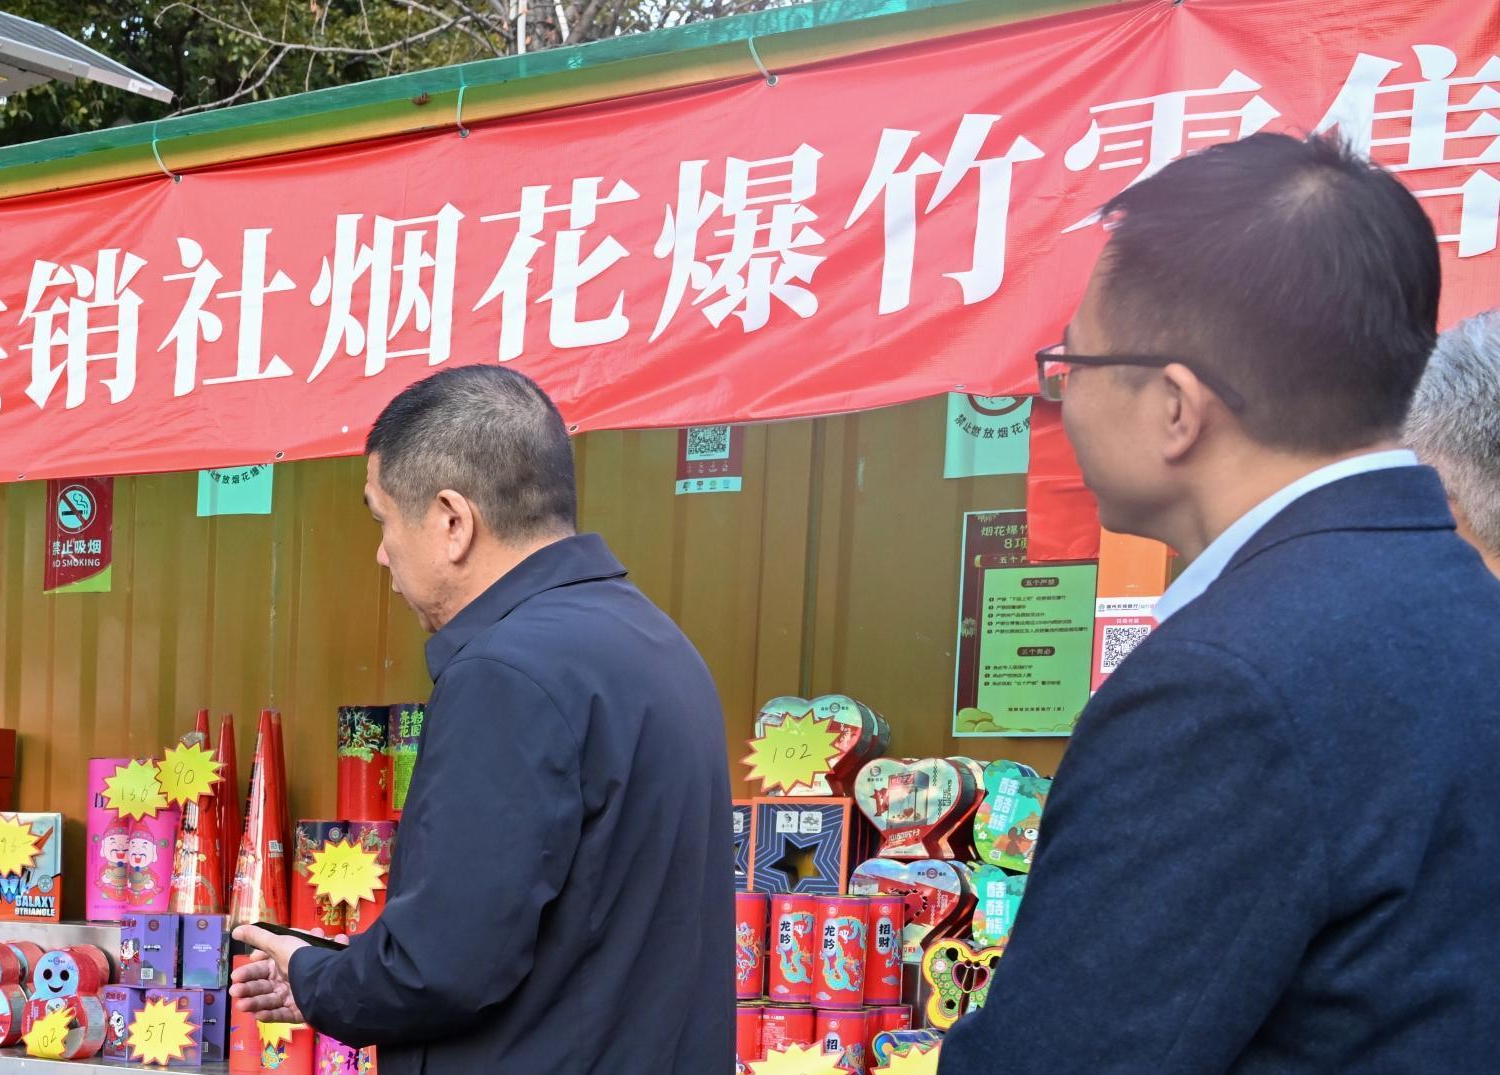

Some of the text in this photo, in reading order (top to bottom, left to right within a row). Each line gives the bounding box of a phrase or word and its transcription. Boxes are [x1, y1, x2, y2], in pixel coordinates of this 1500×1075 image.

[53, 539, 102, 554] 禁止吸烟
[62, 558, 101, 567] SMOKING
[772, 743, 812, 765] 102
[174, 762, 196, 786] 90
[15, 895, 56, 908] GALAXY
[780, 921, 792, 945] 龙吟
[823, 926, 836, 950] 龙吟
[878, 924, 891, 948] 招财
[37, 1027, 57, 1055] 102
[145, 1022, 166, 1044] 57
[826, 1039, 838, 1051] 招
